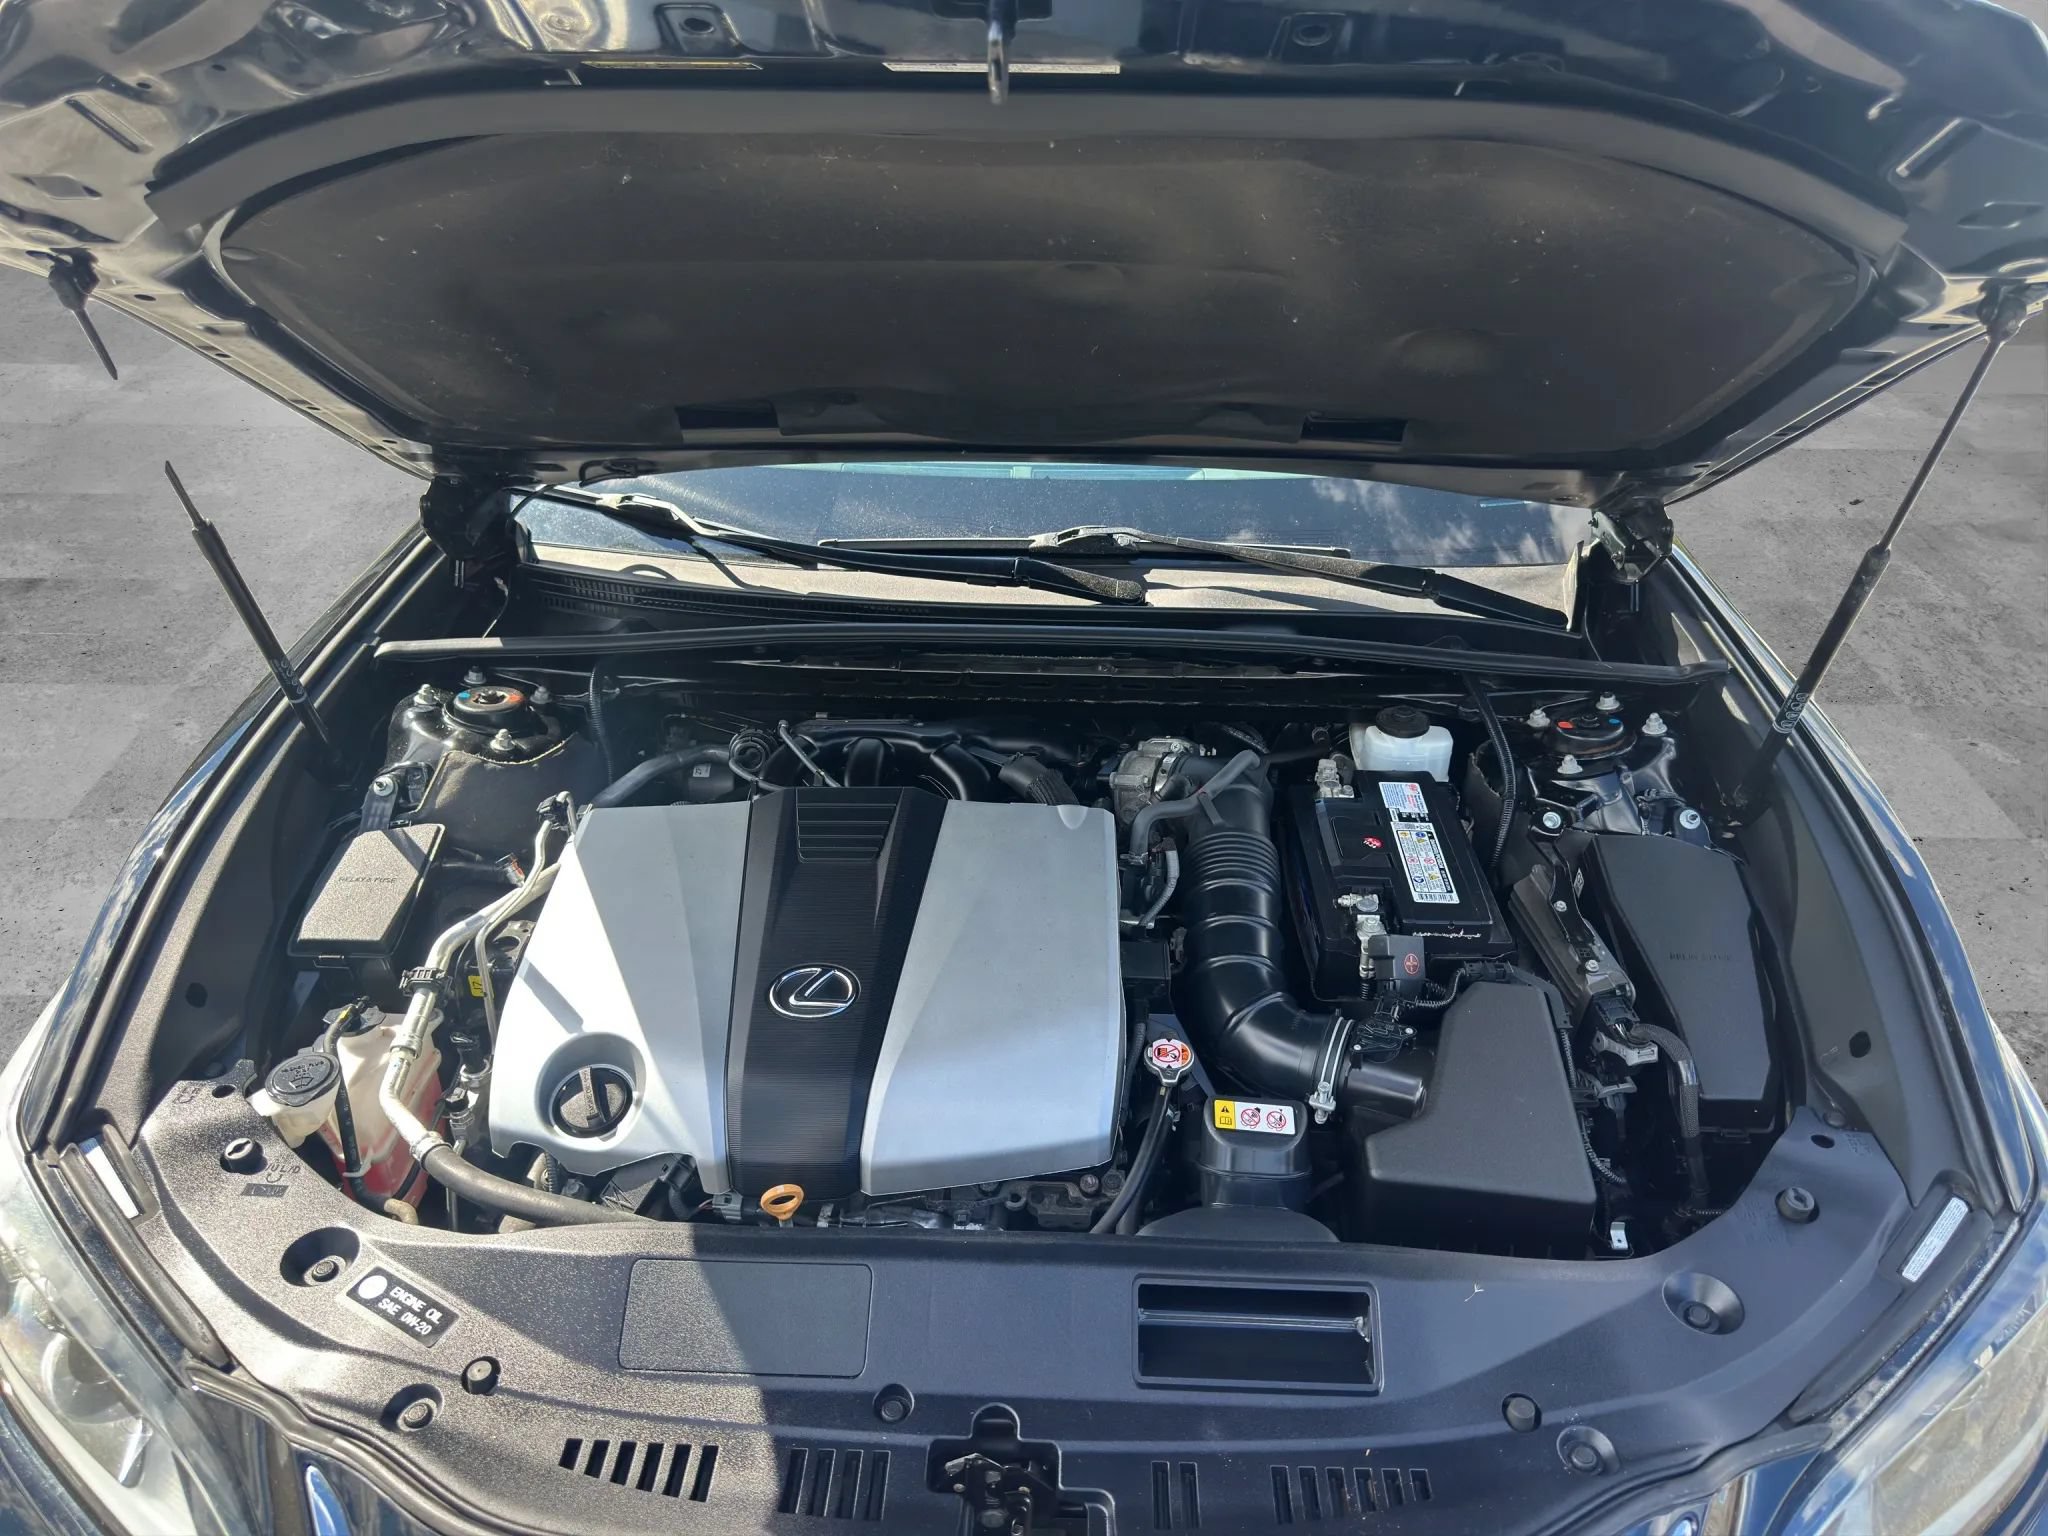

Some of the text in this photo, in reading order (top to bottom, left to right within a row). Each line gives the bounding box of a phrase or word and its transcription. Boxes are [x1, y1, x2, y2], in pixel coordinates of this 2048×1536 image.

[378, 1298, 433, 1335] SAE 0W-20
[389, 1286, 443, 1325] ENGINE OIL
